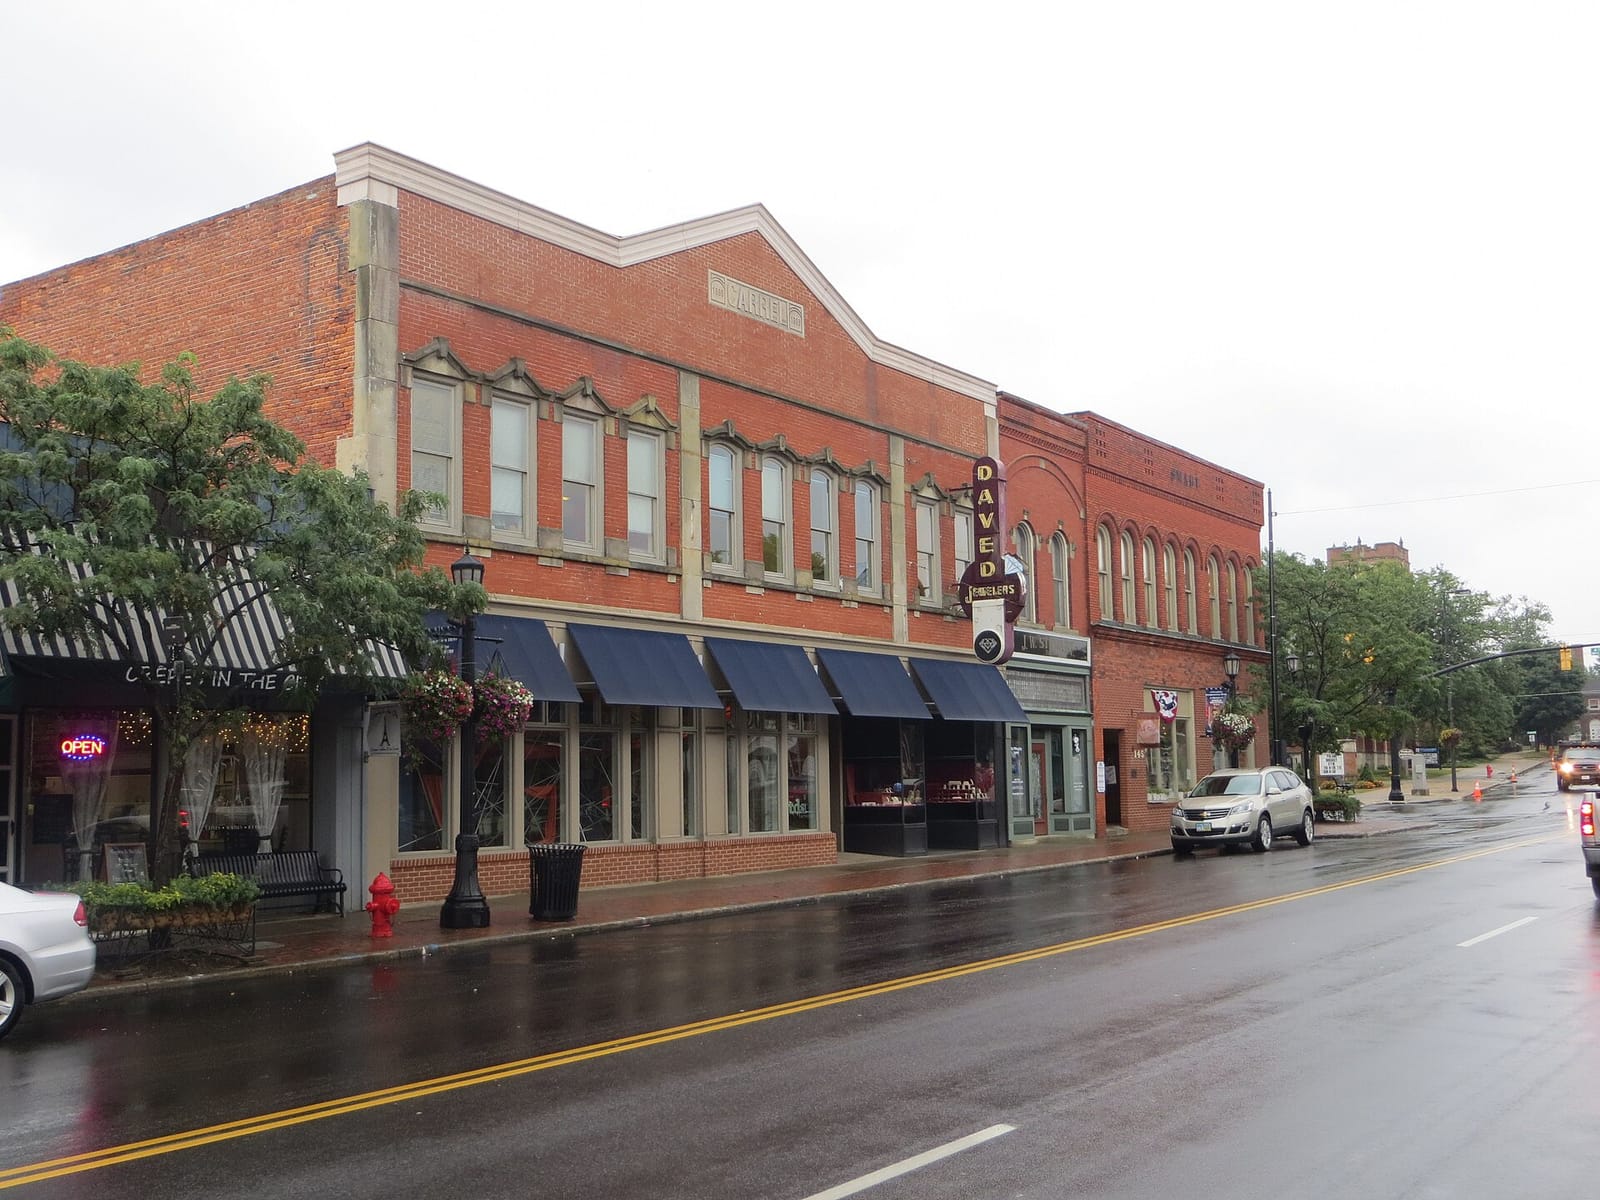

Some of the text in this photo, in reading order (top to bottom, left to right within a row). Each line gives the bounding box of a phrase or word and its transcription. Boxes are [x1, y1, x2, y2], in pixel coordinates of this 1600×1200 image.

[977, 465, 996, 577] DAVED
[212, 670, 232, 687] IN
[239, 672, 277, 690] THE
[61, 740, 102, 754] OPEN
